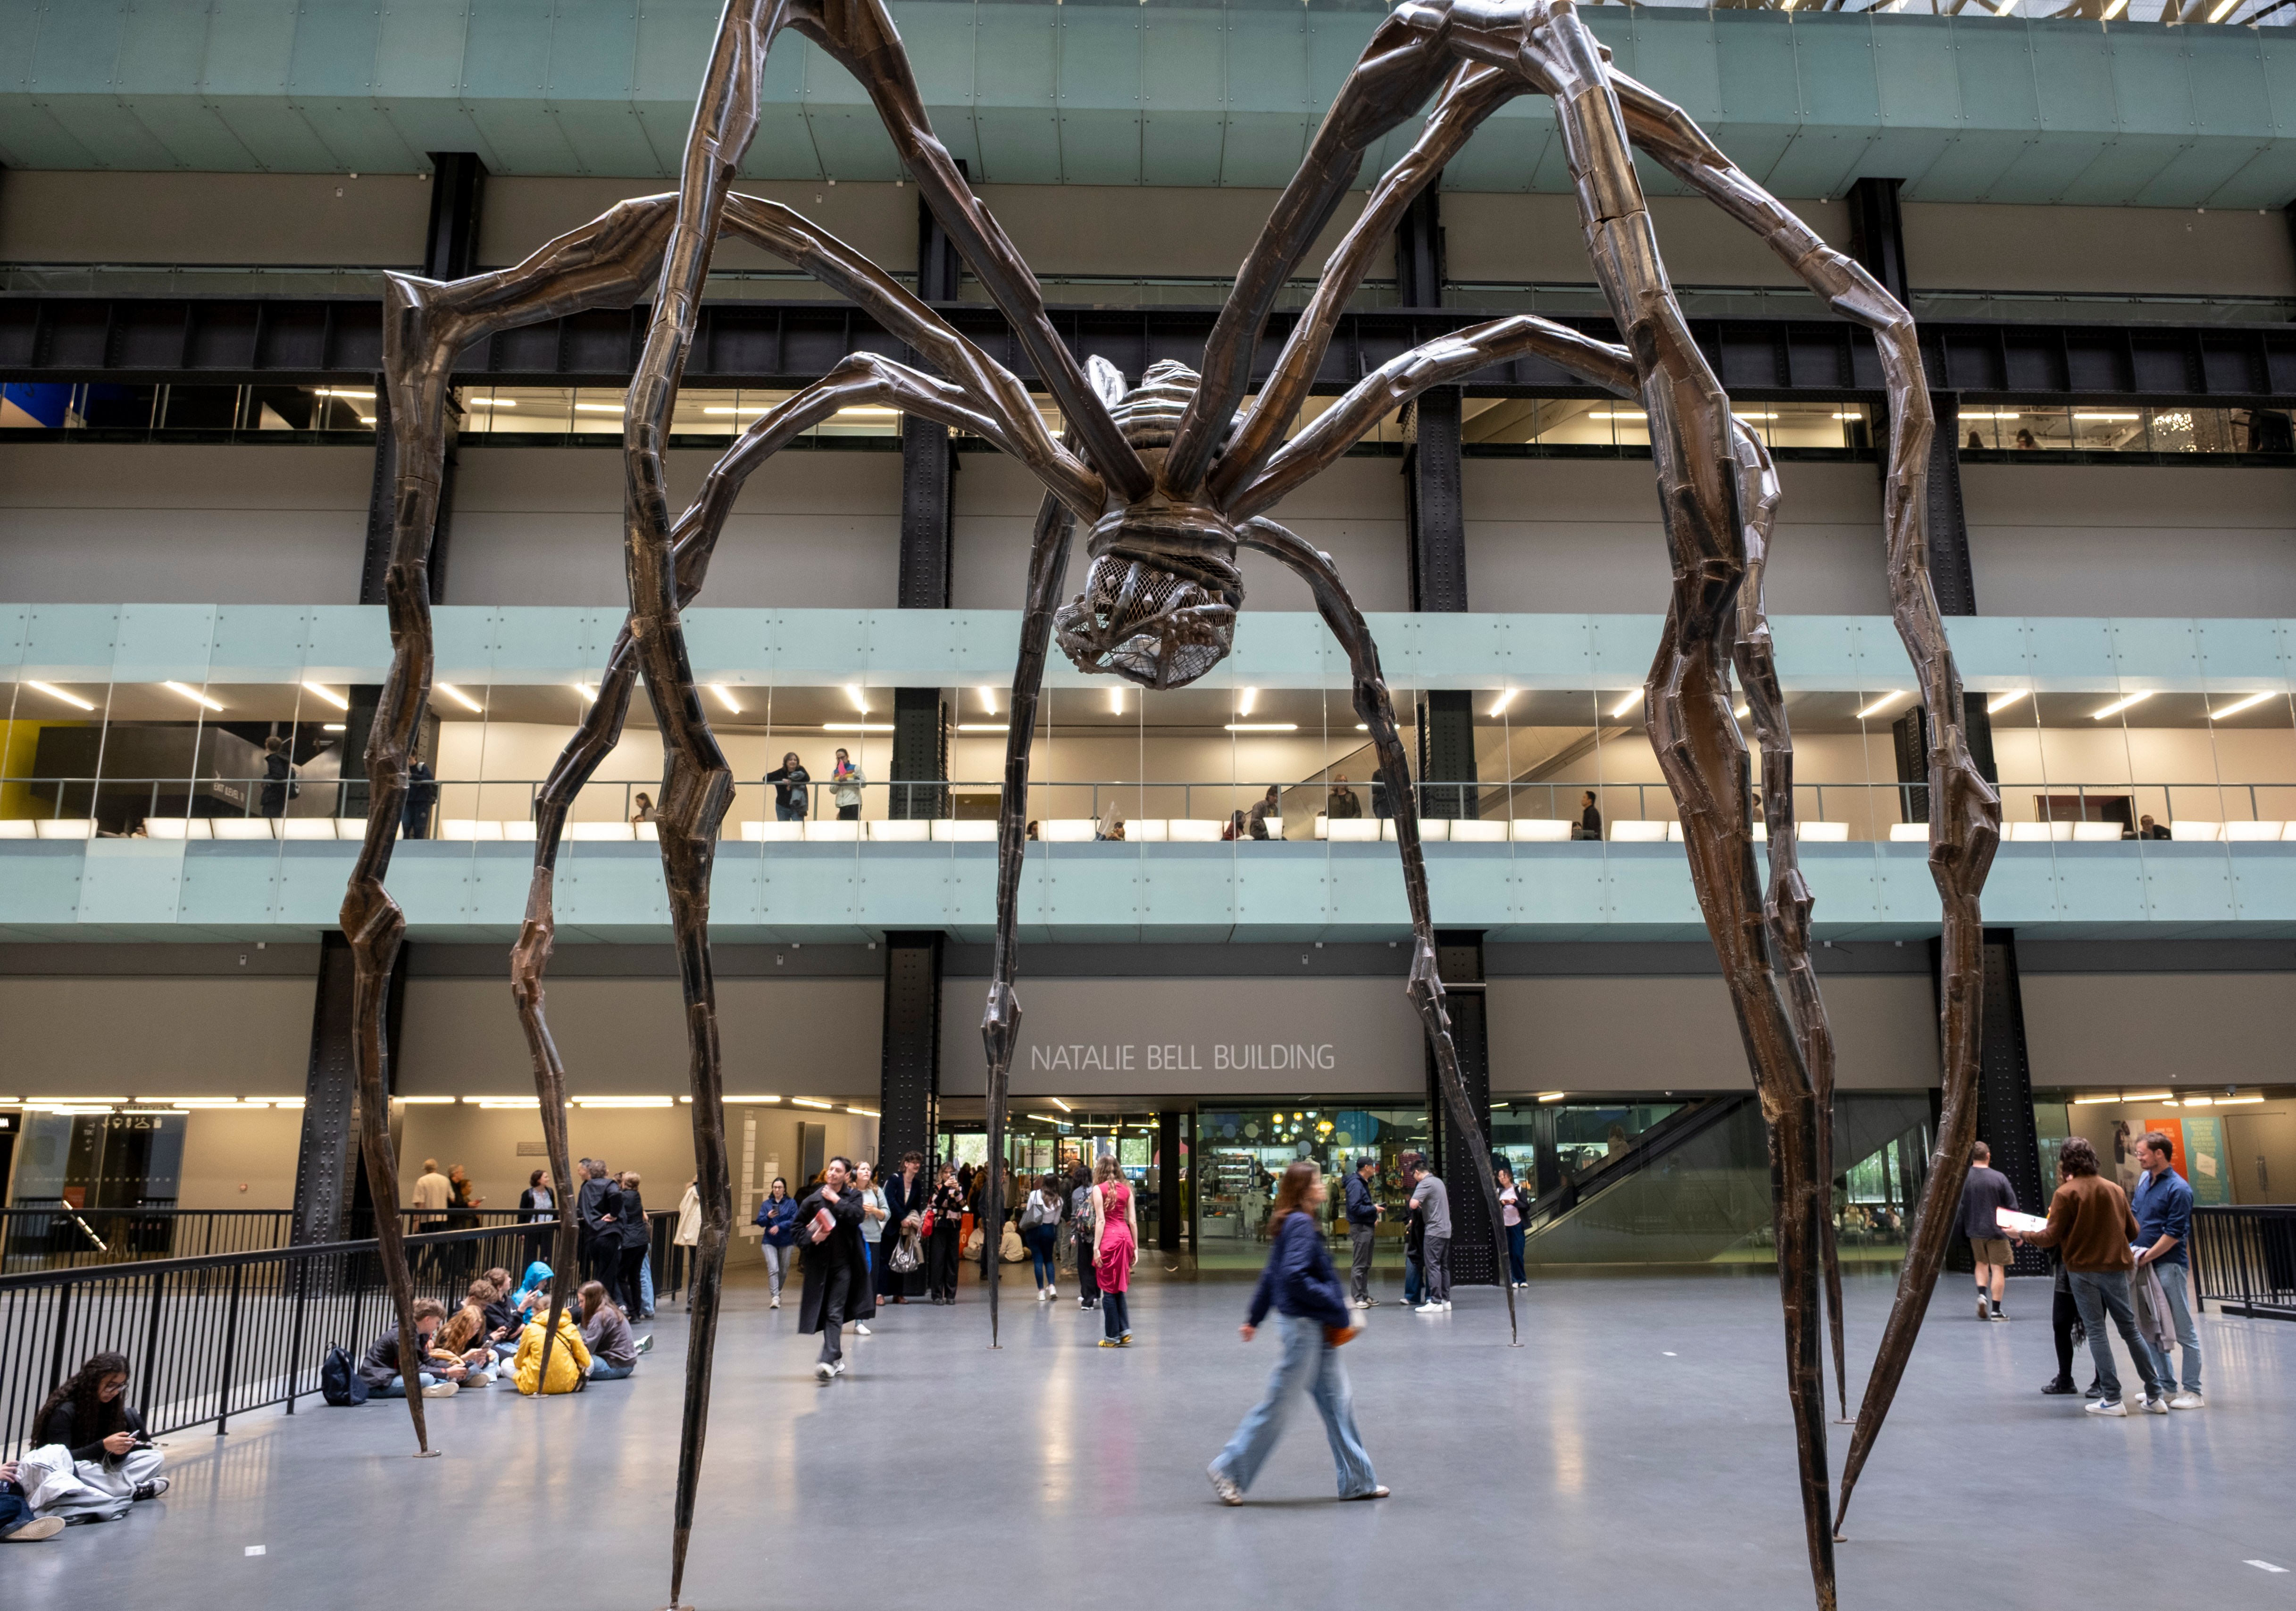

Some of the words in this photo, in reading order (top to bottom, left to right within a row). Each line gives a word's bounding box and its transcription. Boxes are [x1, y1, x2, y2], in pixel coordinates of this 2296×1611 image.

[214, 782, 225, 793] EXIT
[1032, 1045, 1135, 1070] NATALIE
[1147, 1044, 1202, 1069] BELL
[1215, 1044, 1335, 1069] BUILDING
